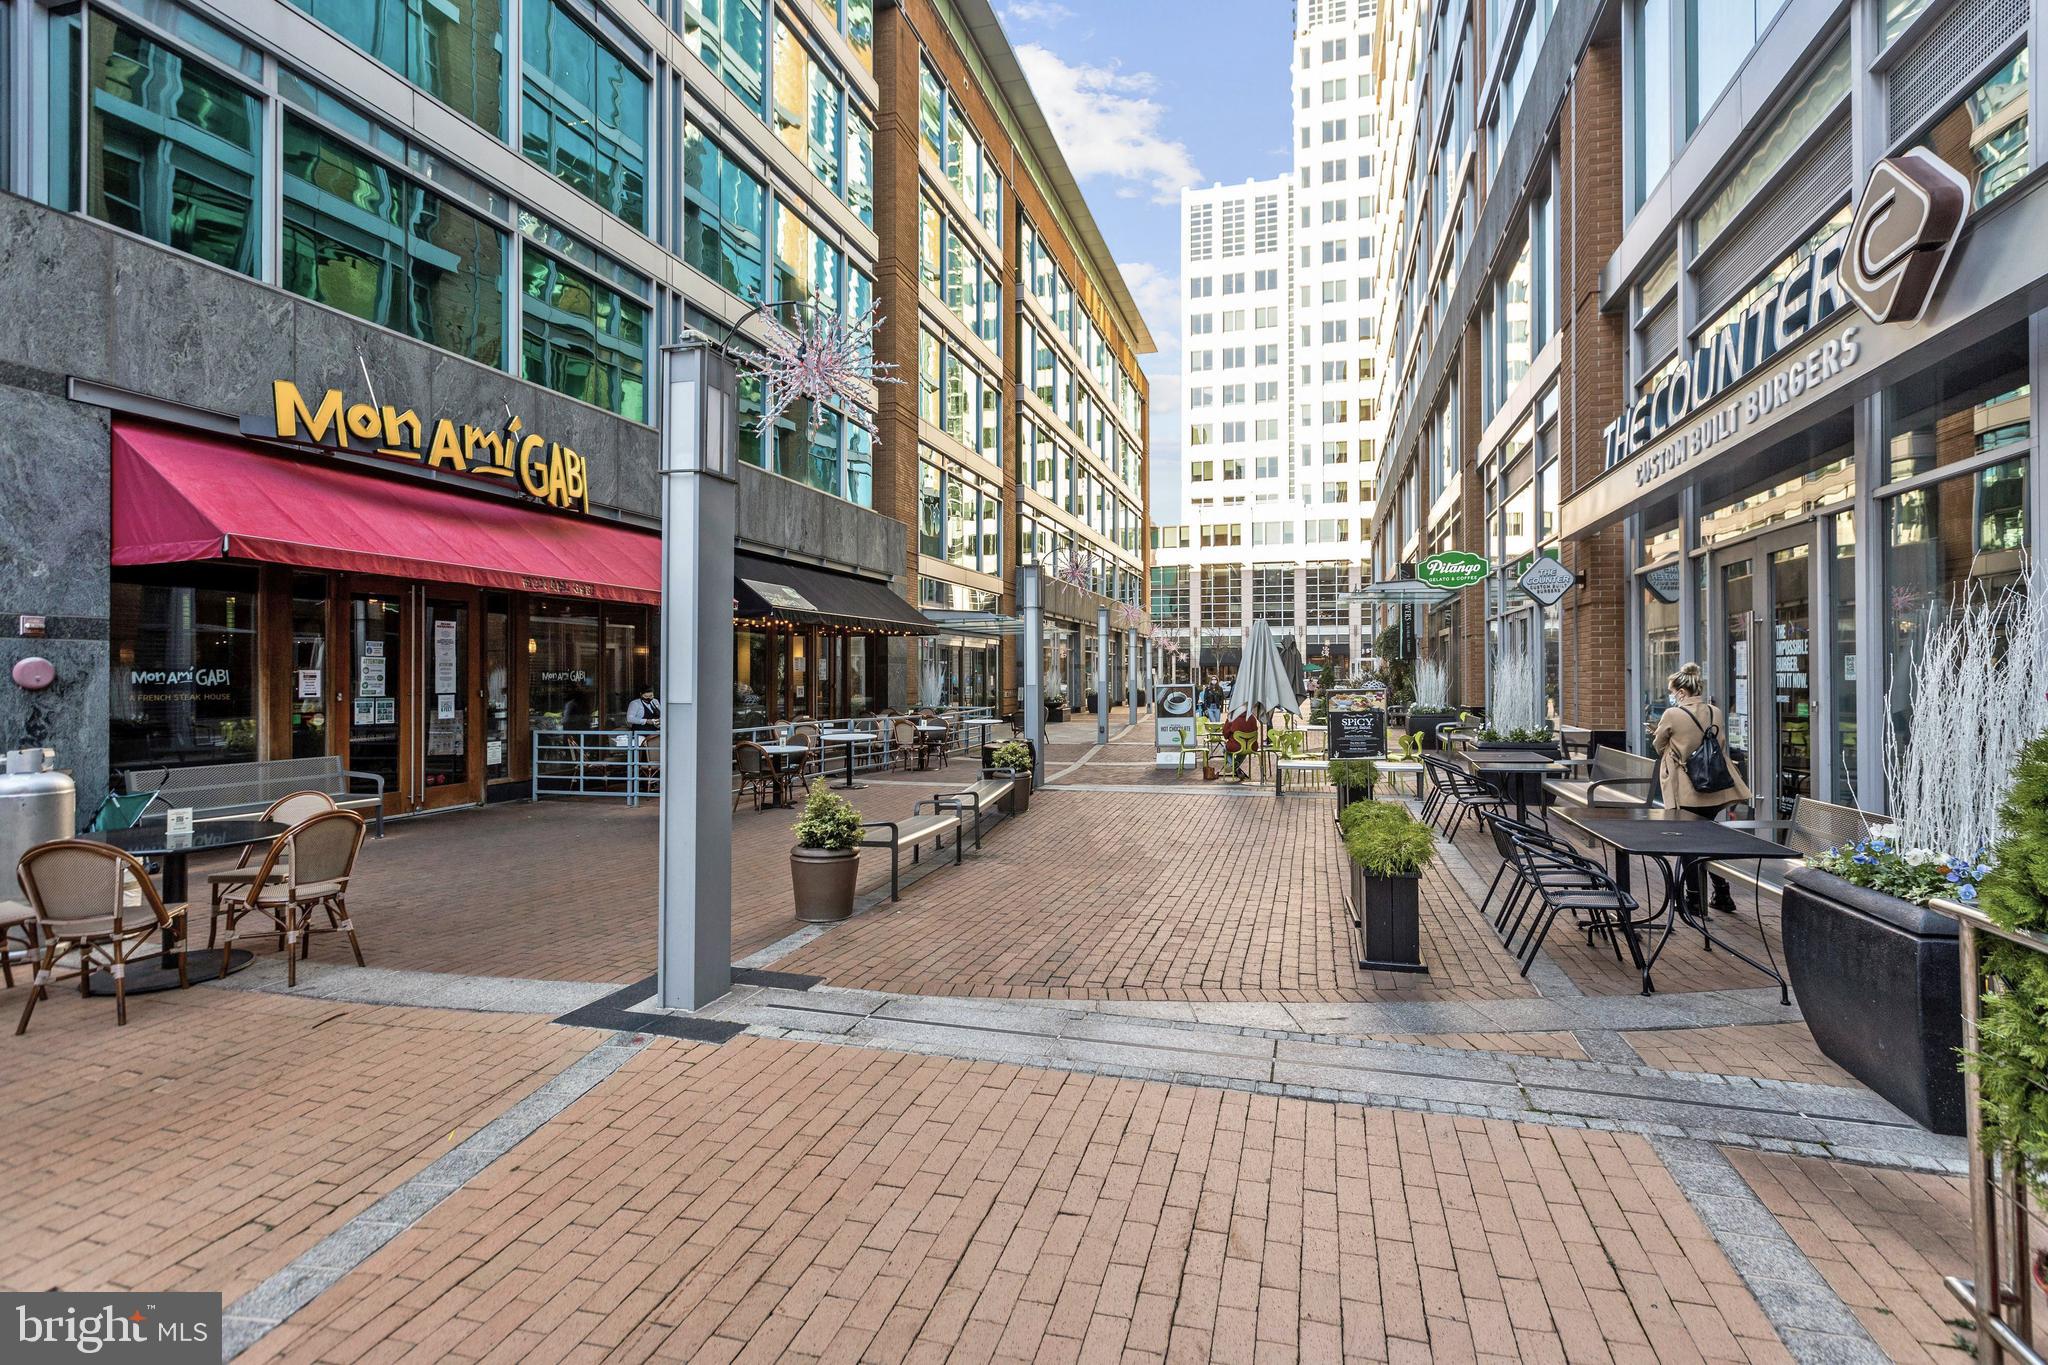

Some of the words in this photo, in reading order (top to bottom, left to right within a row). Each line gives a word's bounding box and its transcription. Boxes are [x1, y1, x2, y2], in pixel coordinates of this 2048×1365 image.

[1603, 394, 1655, 470] THE
[1650, 225, 1852, 436] COUNTER
[1635, 430, 1688, 488] CUSTOM
[1690, 401, 1742, 455] BUILT
[1744, 326, 1862, 424] BURGERS
[272, 379, 422, 459] Mon
[516, 433, 589, 514] GABI
[1426, 559, 1481, 576] Pitango
[1538, 568, 1557, 576] THE
[1527, 575, 1571, 585] COUNTER
[1776, 624, 1786, 640] THE
[1776, 639, 1808, 656] IMPOSSIBLE
[131, 671, 166, 685] Mon
[195, 669, 230, 686] GABI
[570, 670, 586, 682] GABI
[1776, 673, 1787, 688] TRY
[1787, 673, 1792, 688] IT
